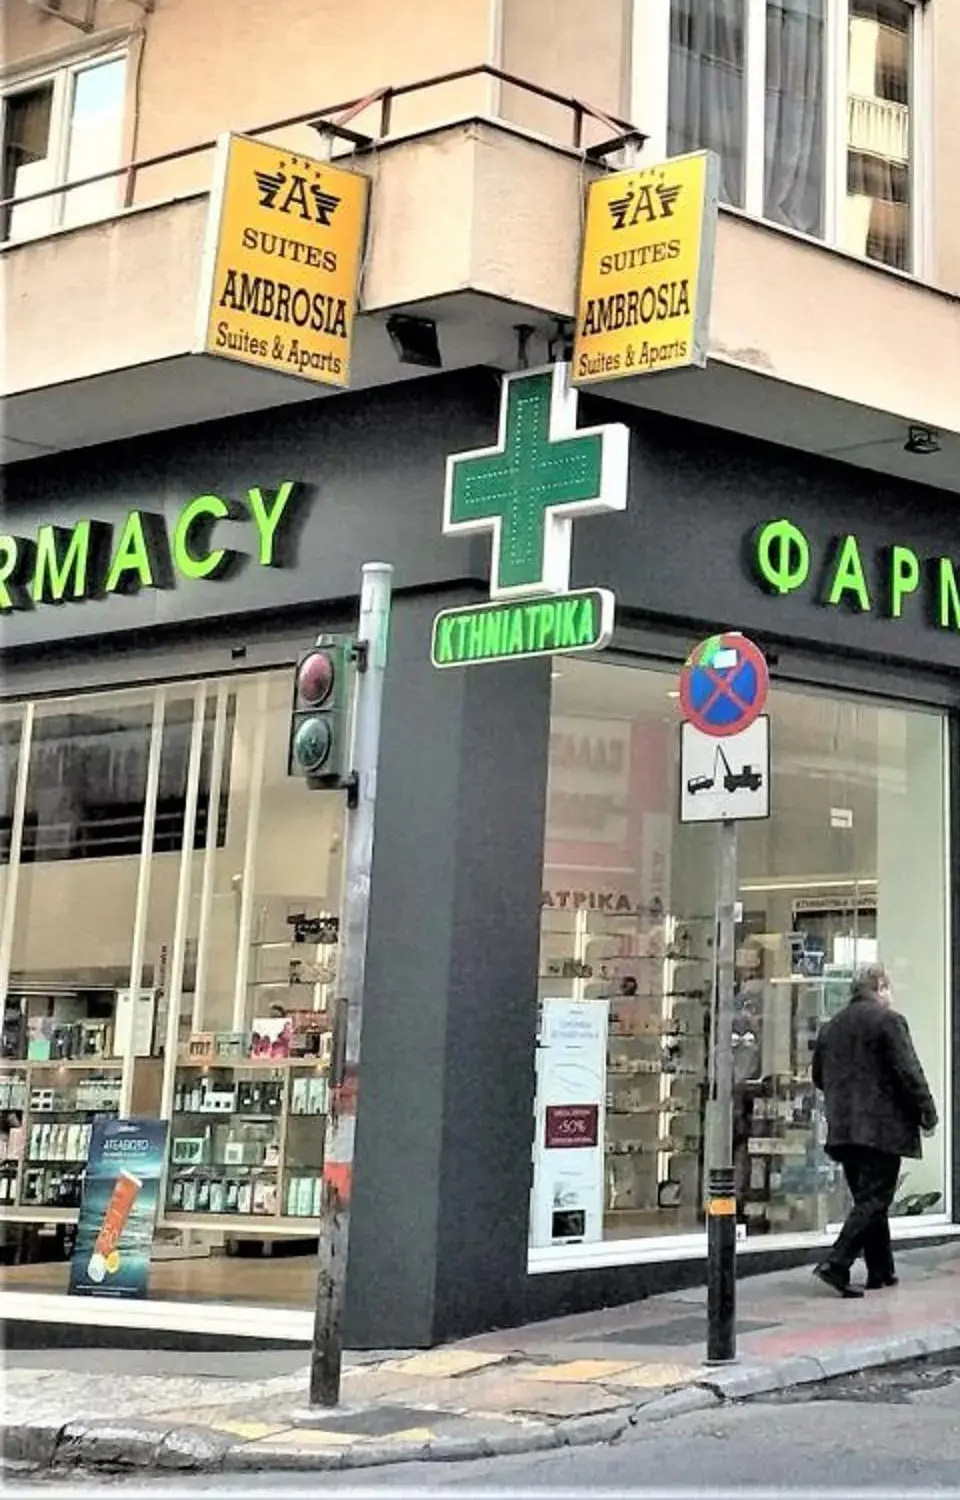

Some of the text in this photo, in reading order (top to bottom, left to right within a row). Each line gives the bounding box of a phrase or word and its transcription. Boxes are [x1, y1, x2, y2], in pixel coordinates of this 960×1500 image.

[242, 227, 338, 273] SUITES
[599, 239, 682, 275] SUITES
[219, 268, 348, 338] AMBROSIA
[581, 279, 690, 337] AMBROSIA
[216, 321, 342, 374] Suites & Aparts
[578, 339, 687, 377] Suites & Aparts
[439, 598, 595, 663] ΚΤΗΝΙΑΤΡΙΚΑ
